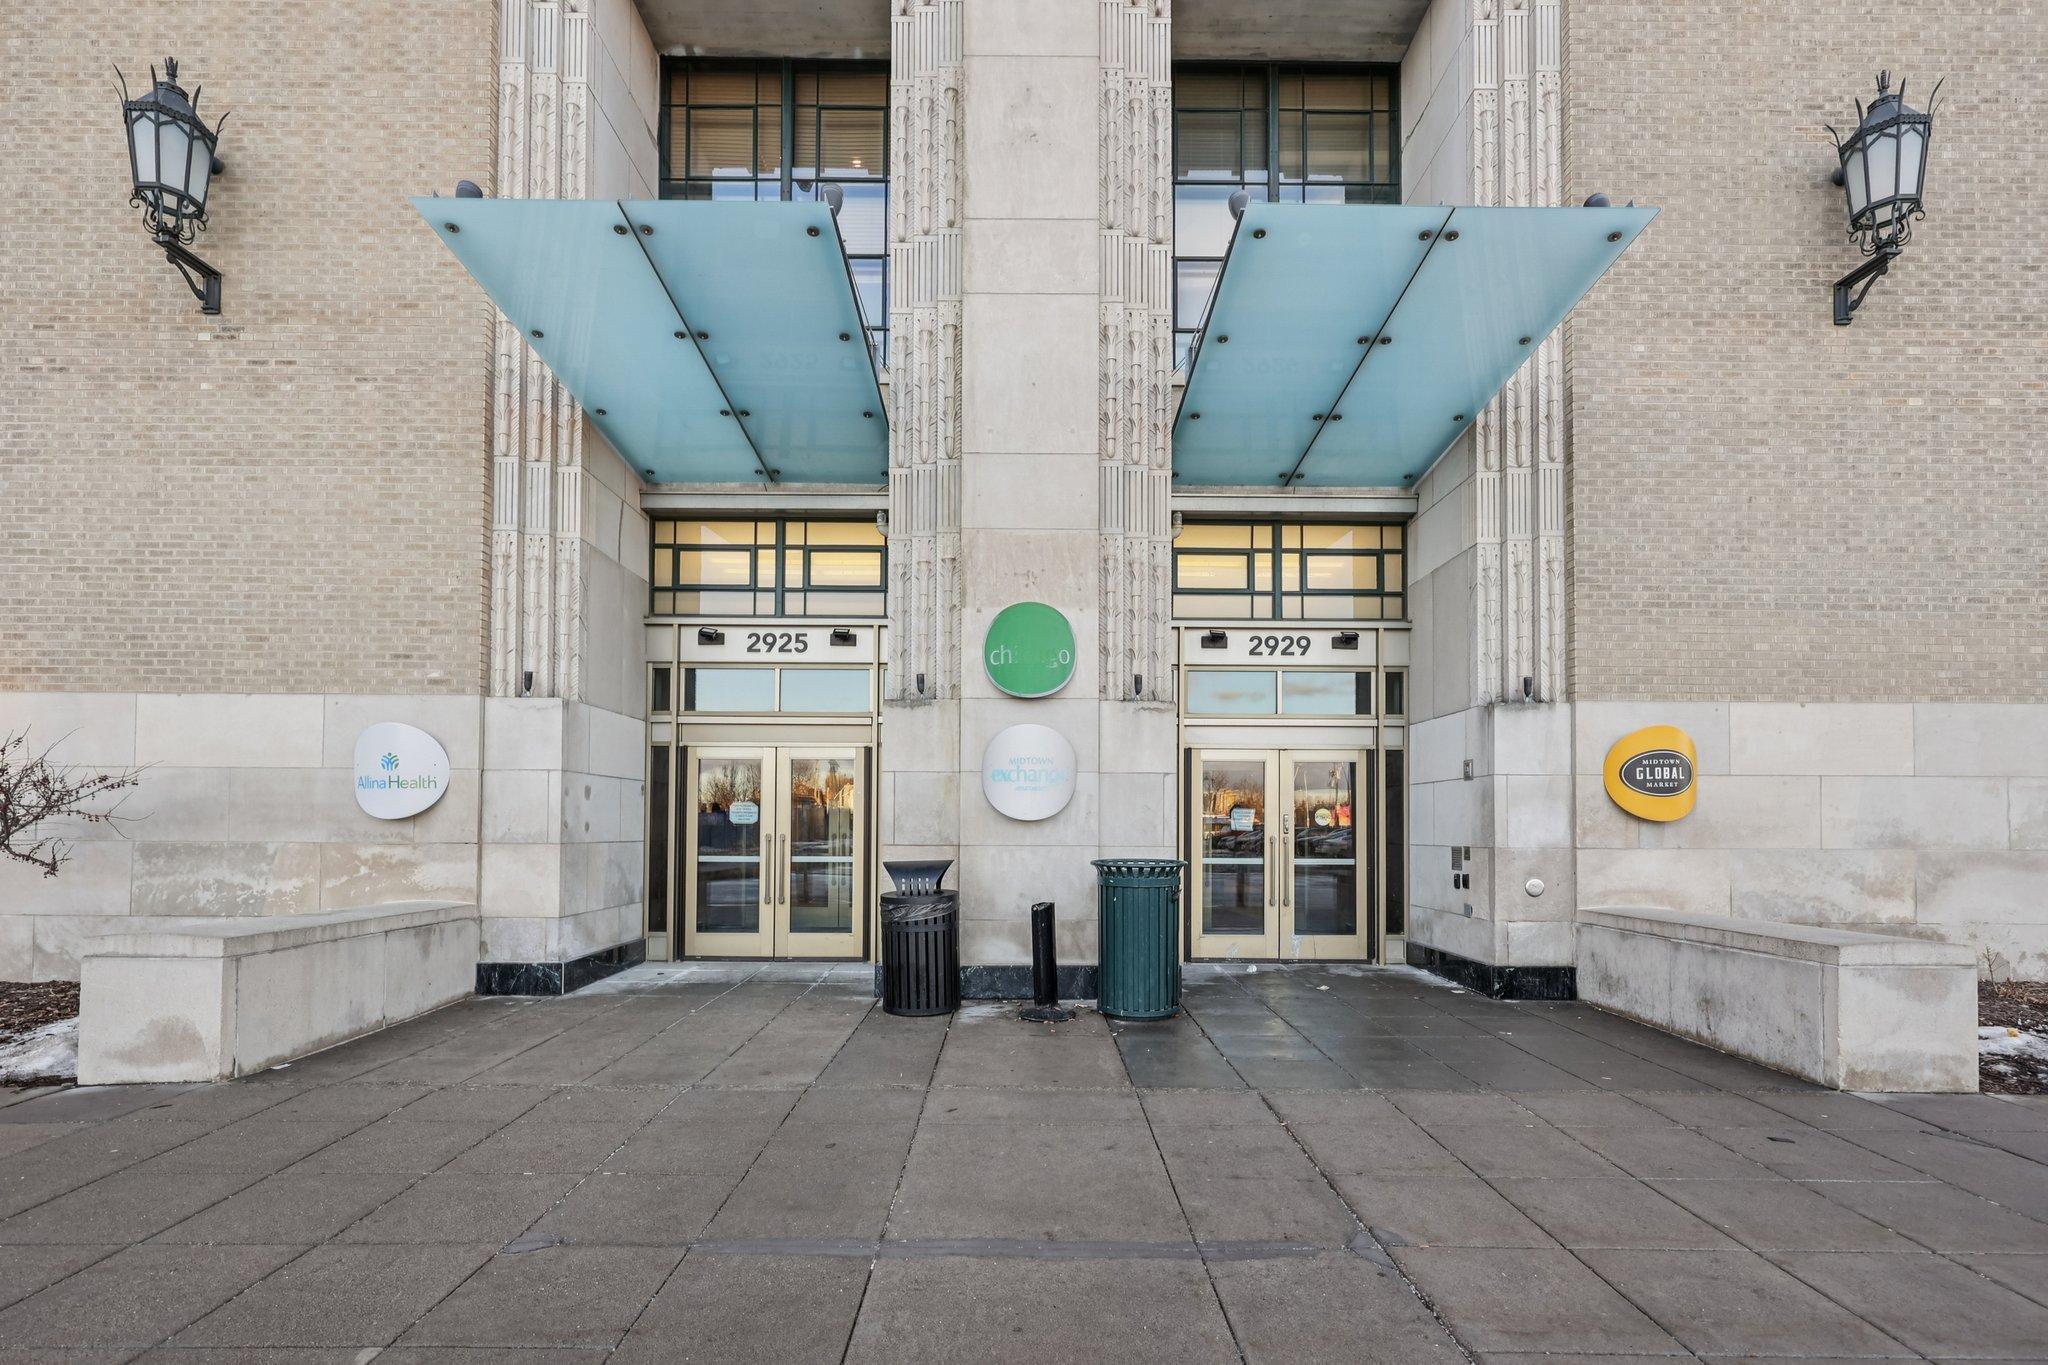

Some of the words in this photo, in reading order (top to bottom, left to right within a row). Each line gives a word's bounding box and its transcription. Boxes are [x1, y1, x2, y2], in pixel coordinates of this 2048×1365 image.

[747, 633, 808, 653] 2925
[1249, 636, 1311, 656] 2929
[1008, 755, 1055, 766] MIDTOWN
[1636, 767, 1685, 779] GLOBAL
[357, 775, 387, 789] Allina
[389, 775, 437, 789] Health
